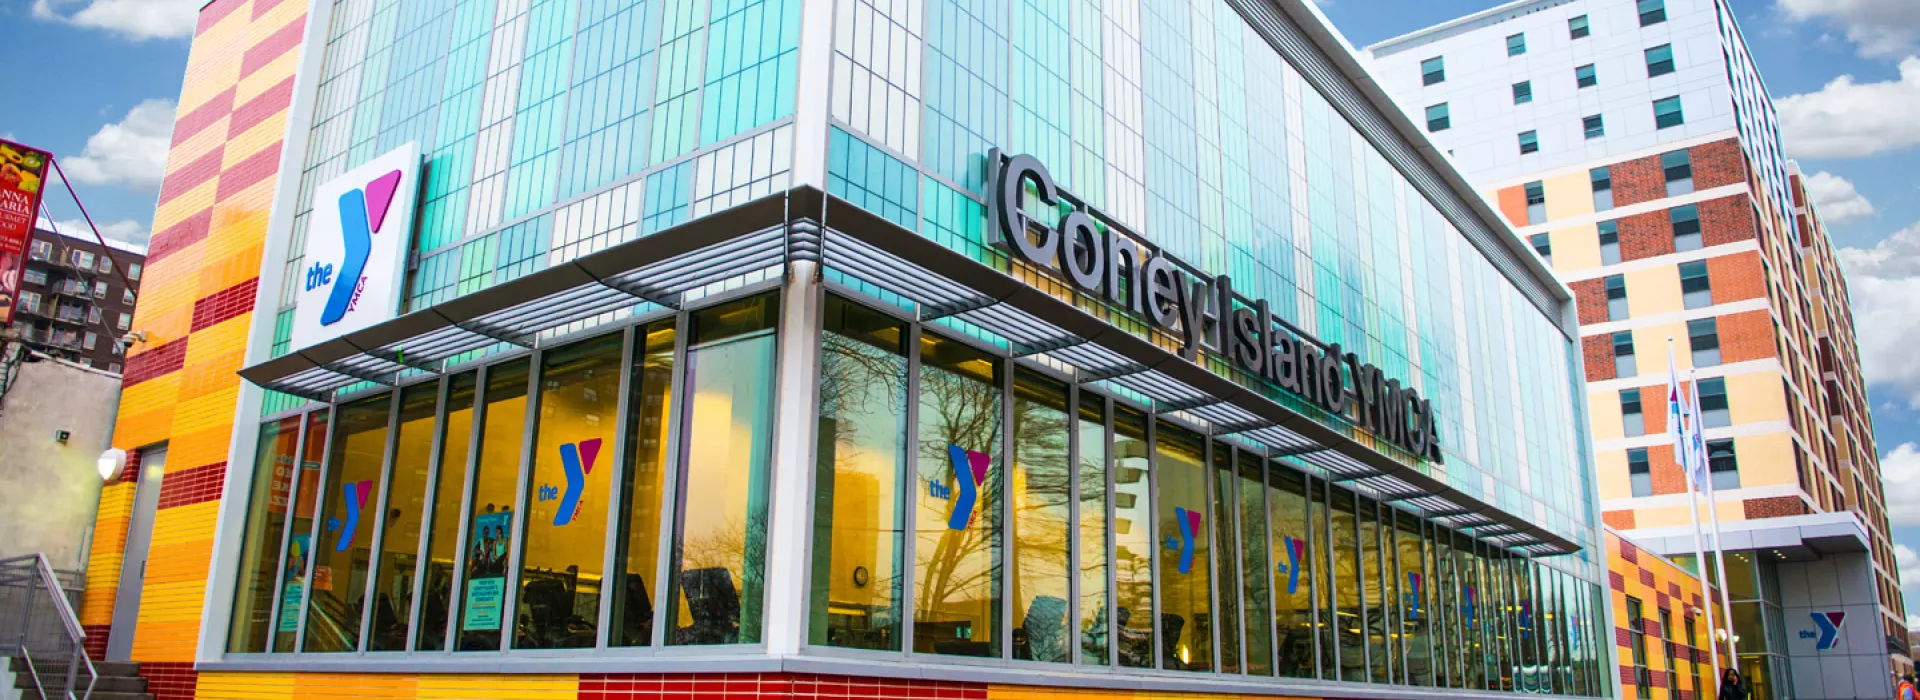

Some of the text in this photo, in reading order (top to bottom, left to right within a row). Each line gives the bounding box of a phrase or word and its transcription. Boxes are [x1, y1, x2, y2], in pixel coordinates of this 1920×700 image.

[305, 261, 333, 292] the
[347, 276, 368, 312] YMCA
[999, 152, 1442, 465] Coney Island YMCA
[538, 483, 558, 502] the
[929, 479, 951, 500] the
